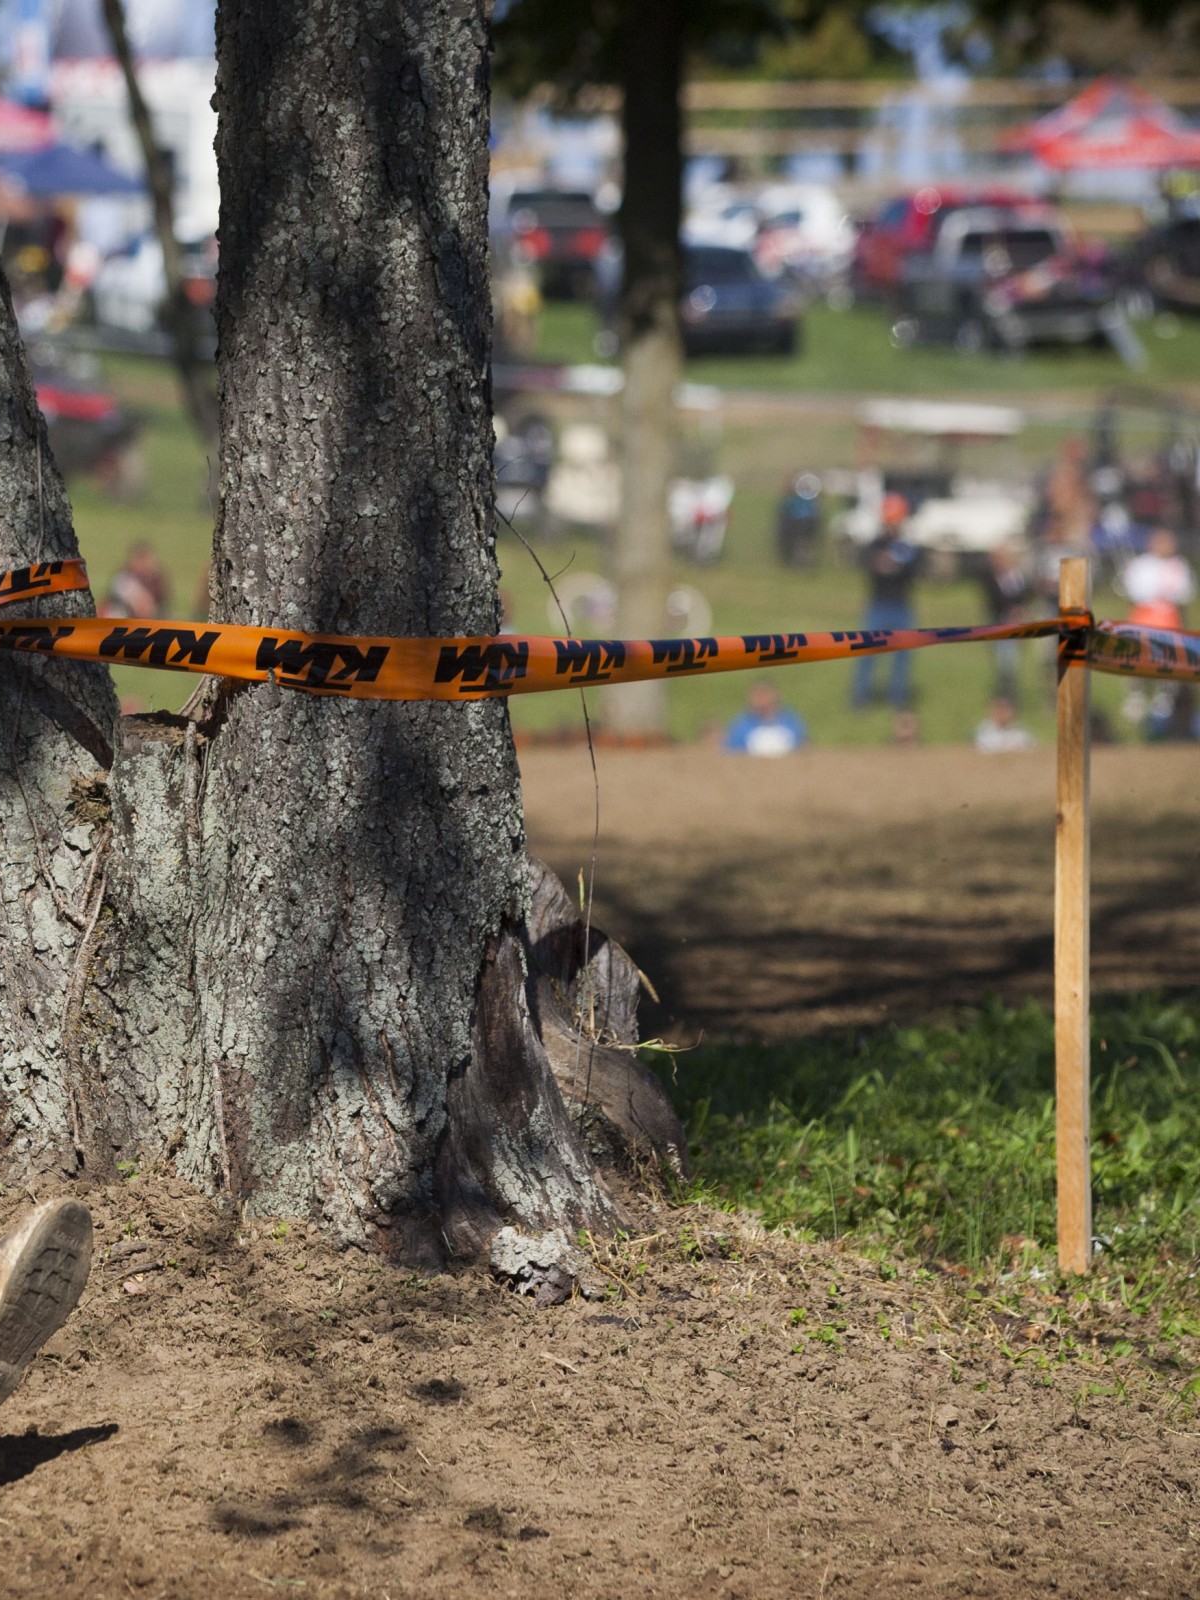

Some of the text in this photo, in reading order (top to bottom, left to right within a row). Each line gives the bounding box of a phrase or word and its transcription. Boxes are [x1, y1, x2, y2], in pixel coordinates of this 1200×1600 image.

[99, 627, 221, 671] KTM
[256, 637, 391, 691] KTM
[433, 641, 529, 692] KTM
[552, 640, 626, 683] KTM
[648, 637, 719, 672] KTM
